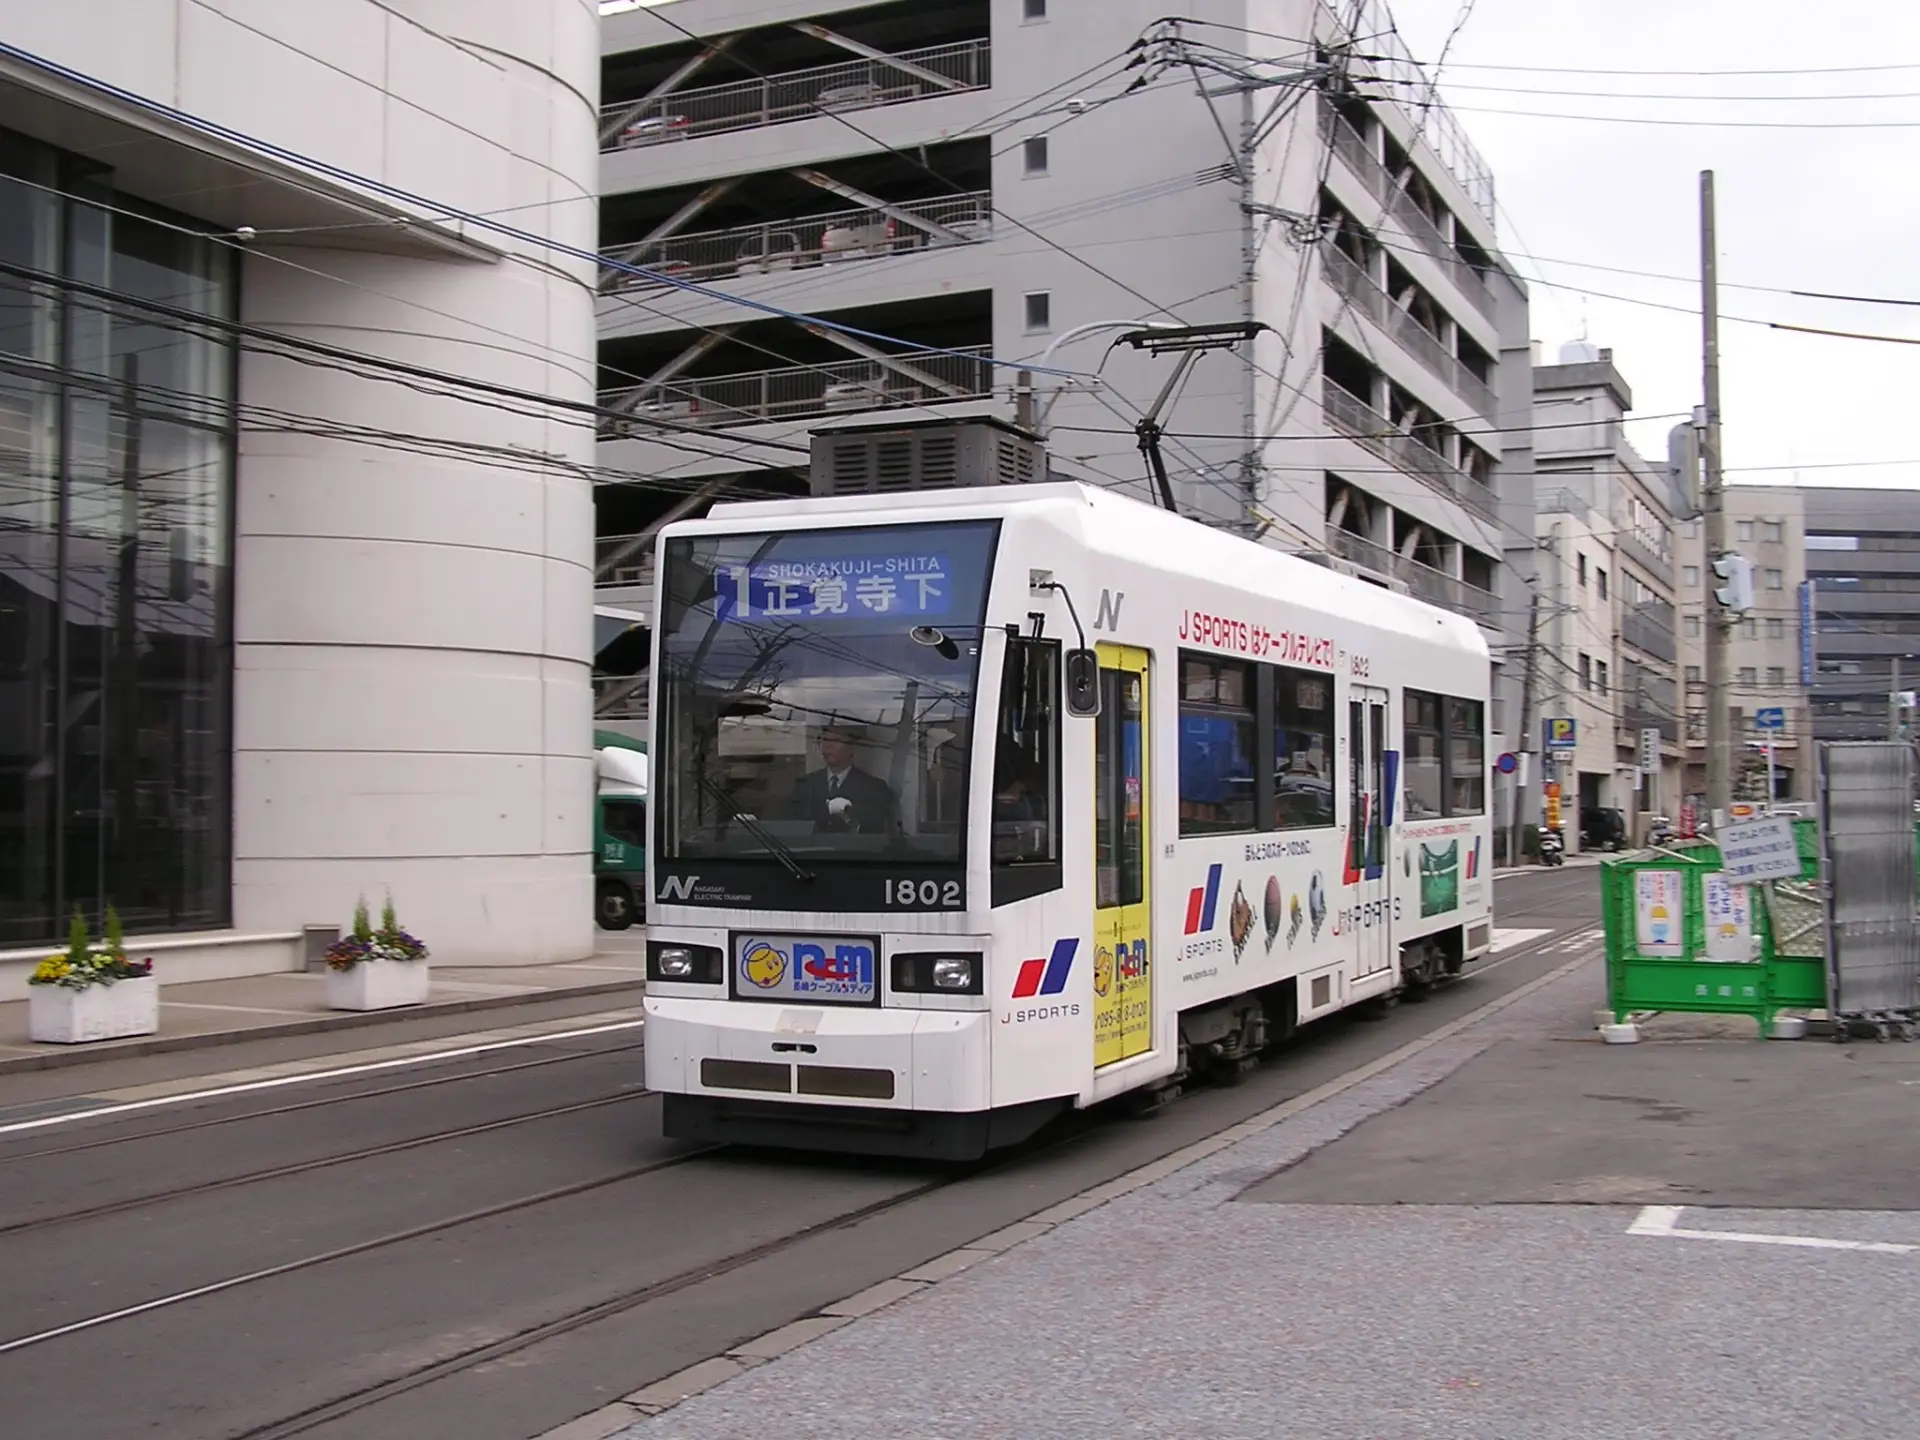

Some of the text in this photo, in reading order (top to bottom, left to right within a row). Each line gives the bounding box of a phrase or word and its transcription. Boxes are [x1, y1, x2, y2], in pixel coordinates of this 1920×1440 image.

[768, 556, 941, 578] SHOKAKUJI-SHITA
[730, 567, 752, 618] 1
[762, 572, 946, 616] 正覚寺下
[1178, 609, 1189, 640] J
[1193, 611, 1248, 651] SPORTS
[884, 878, 961, 906] 1802
[1186, 938, 1223, 959] SPORTS
[1001, 1003, 1080, 1024] J SPORTS
